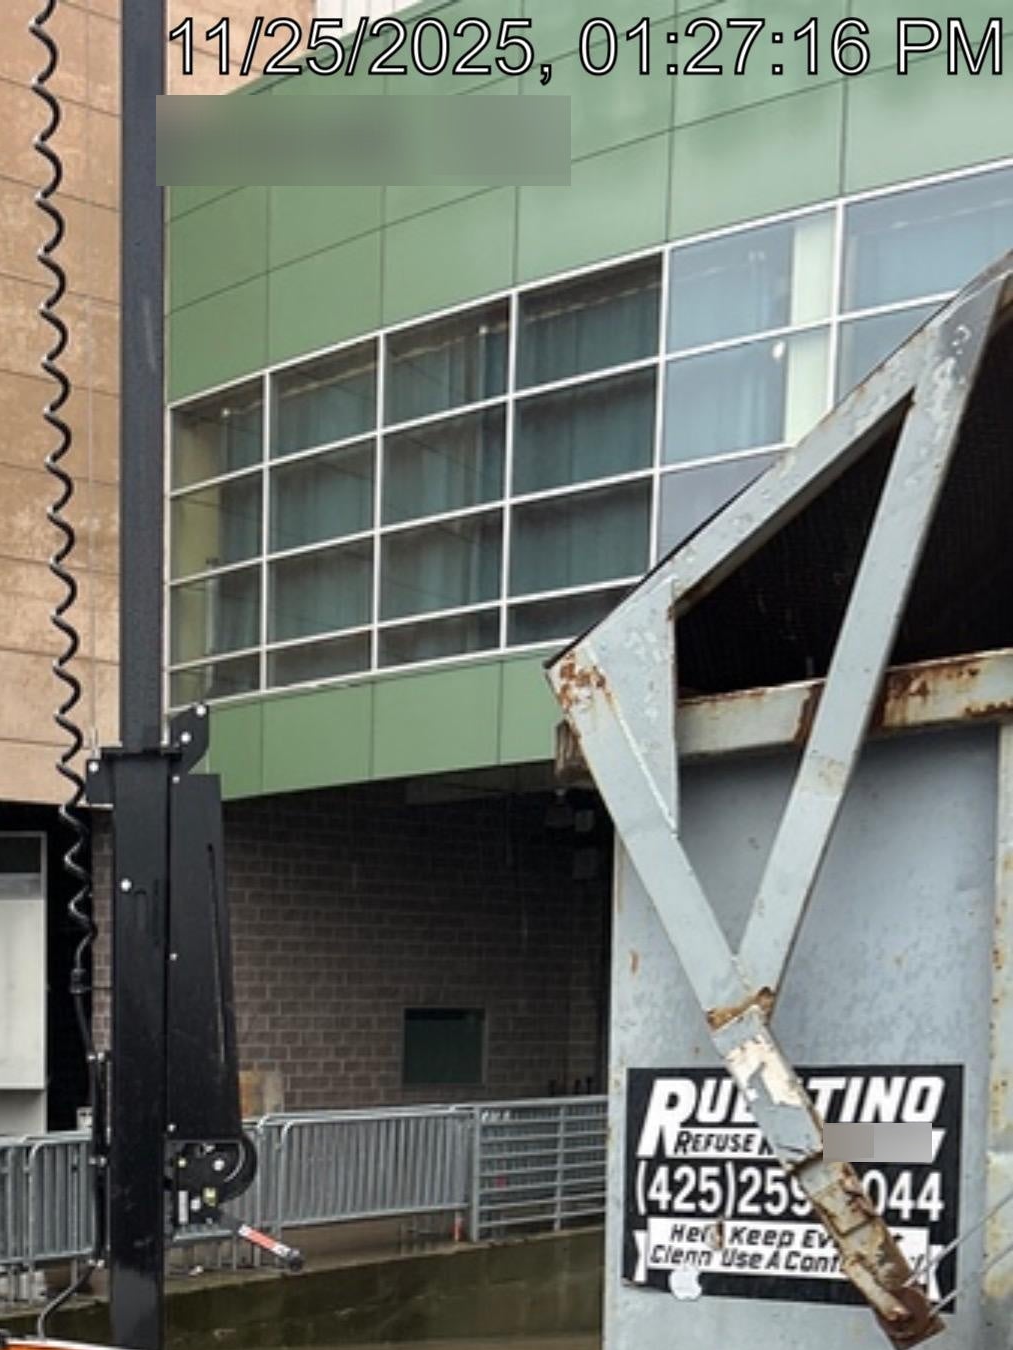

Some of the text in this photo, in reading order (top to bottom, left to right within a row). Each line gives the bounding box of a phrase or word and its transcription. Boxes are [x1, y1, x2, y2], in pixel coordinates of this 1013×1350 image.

[674, 1130, 757, 1155] REFUSE
[728, 1226, 795, 1250] Keep
[721, 1248, 763, 1269] Use
[765, 1249, 781, 1270] A
